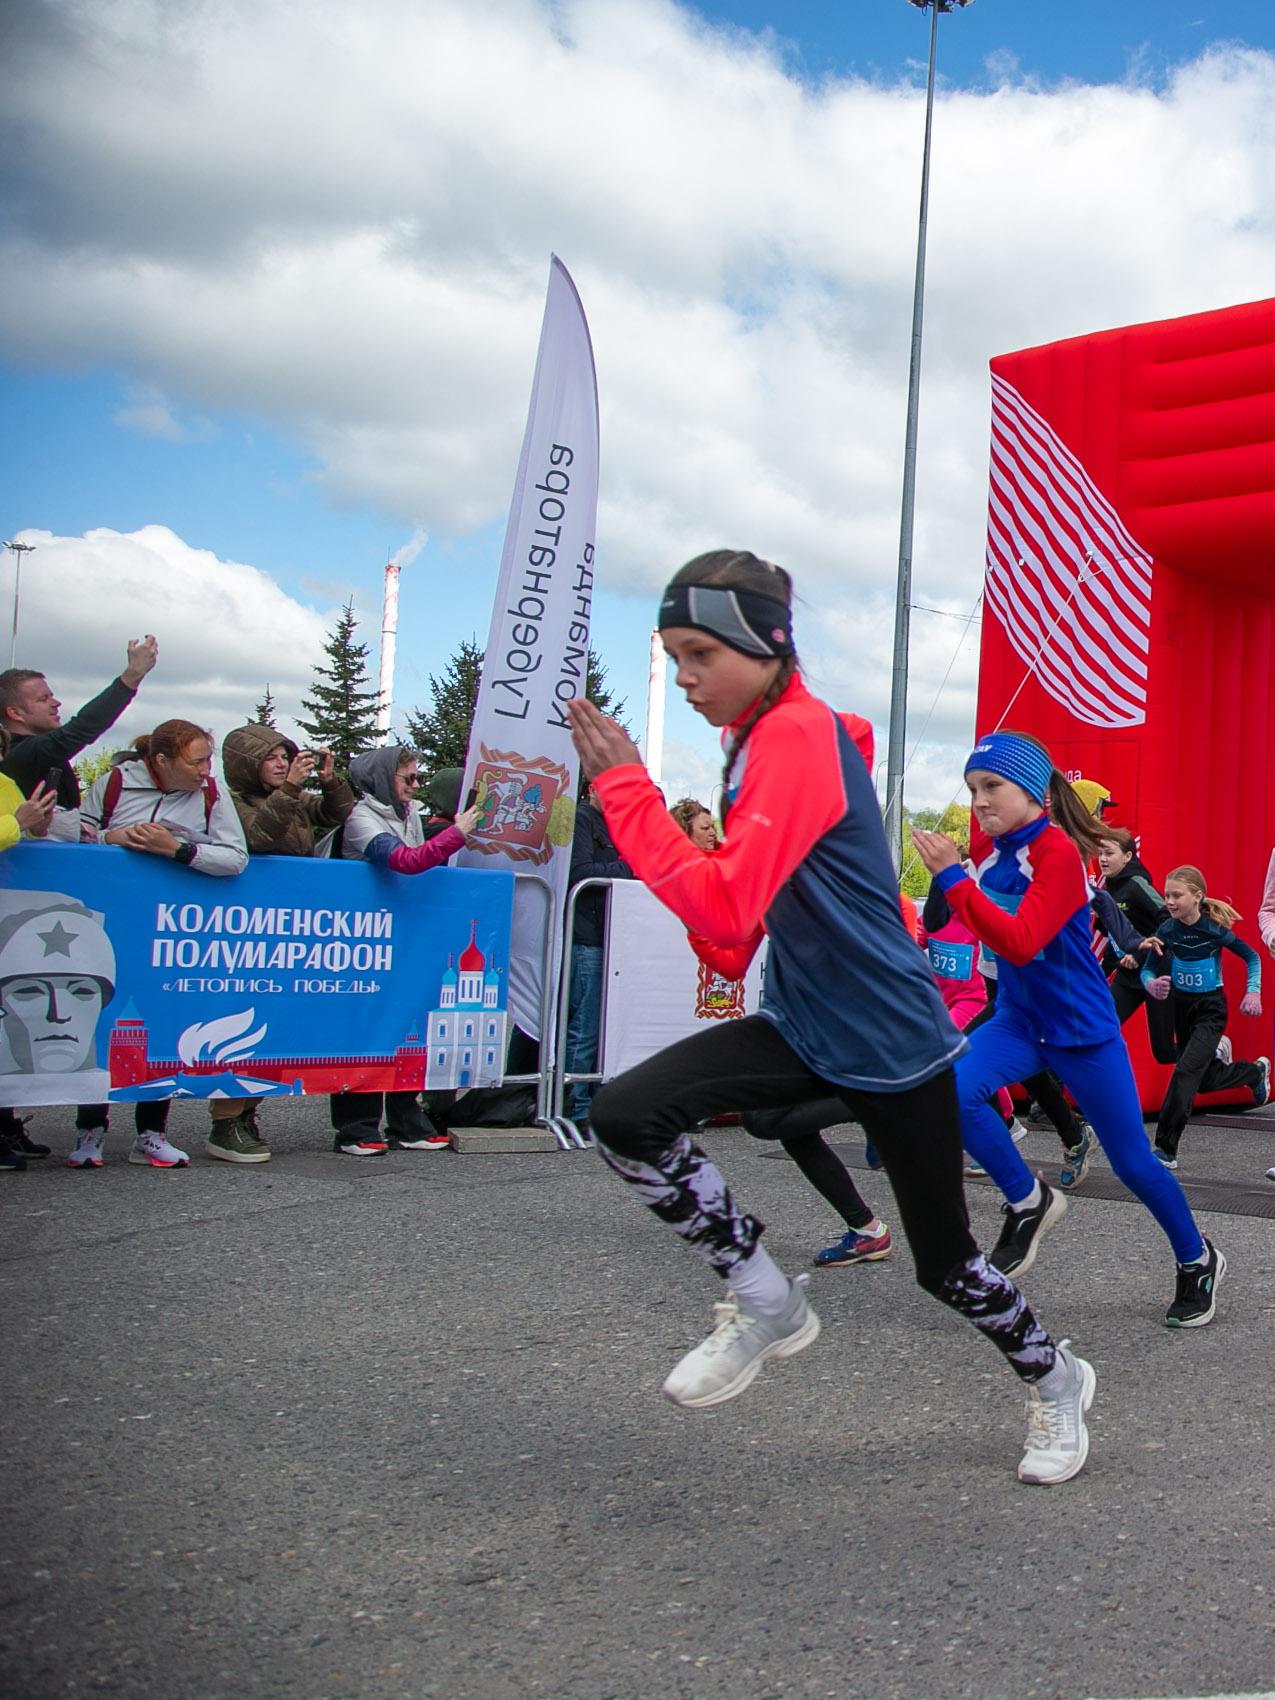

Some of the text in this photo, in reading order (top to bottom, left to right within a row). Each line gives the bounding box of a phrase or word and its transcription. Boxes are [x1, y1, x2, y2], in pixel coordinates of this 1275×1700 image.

[156, 903, 393, 939] КОЛОМЕНСКИЙ
[152, 938, 393, 974] ПОЛУМАРАФОН
[933, 953, 957, 972] 373
[162, 978, 381, 993] «ЛЕТОПИСЬ ПОБЕДЫ»
[1177, 972, 1203, 986] 303
